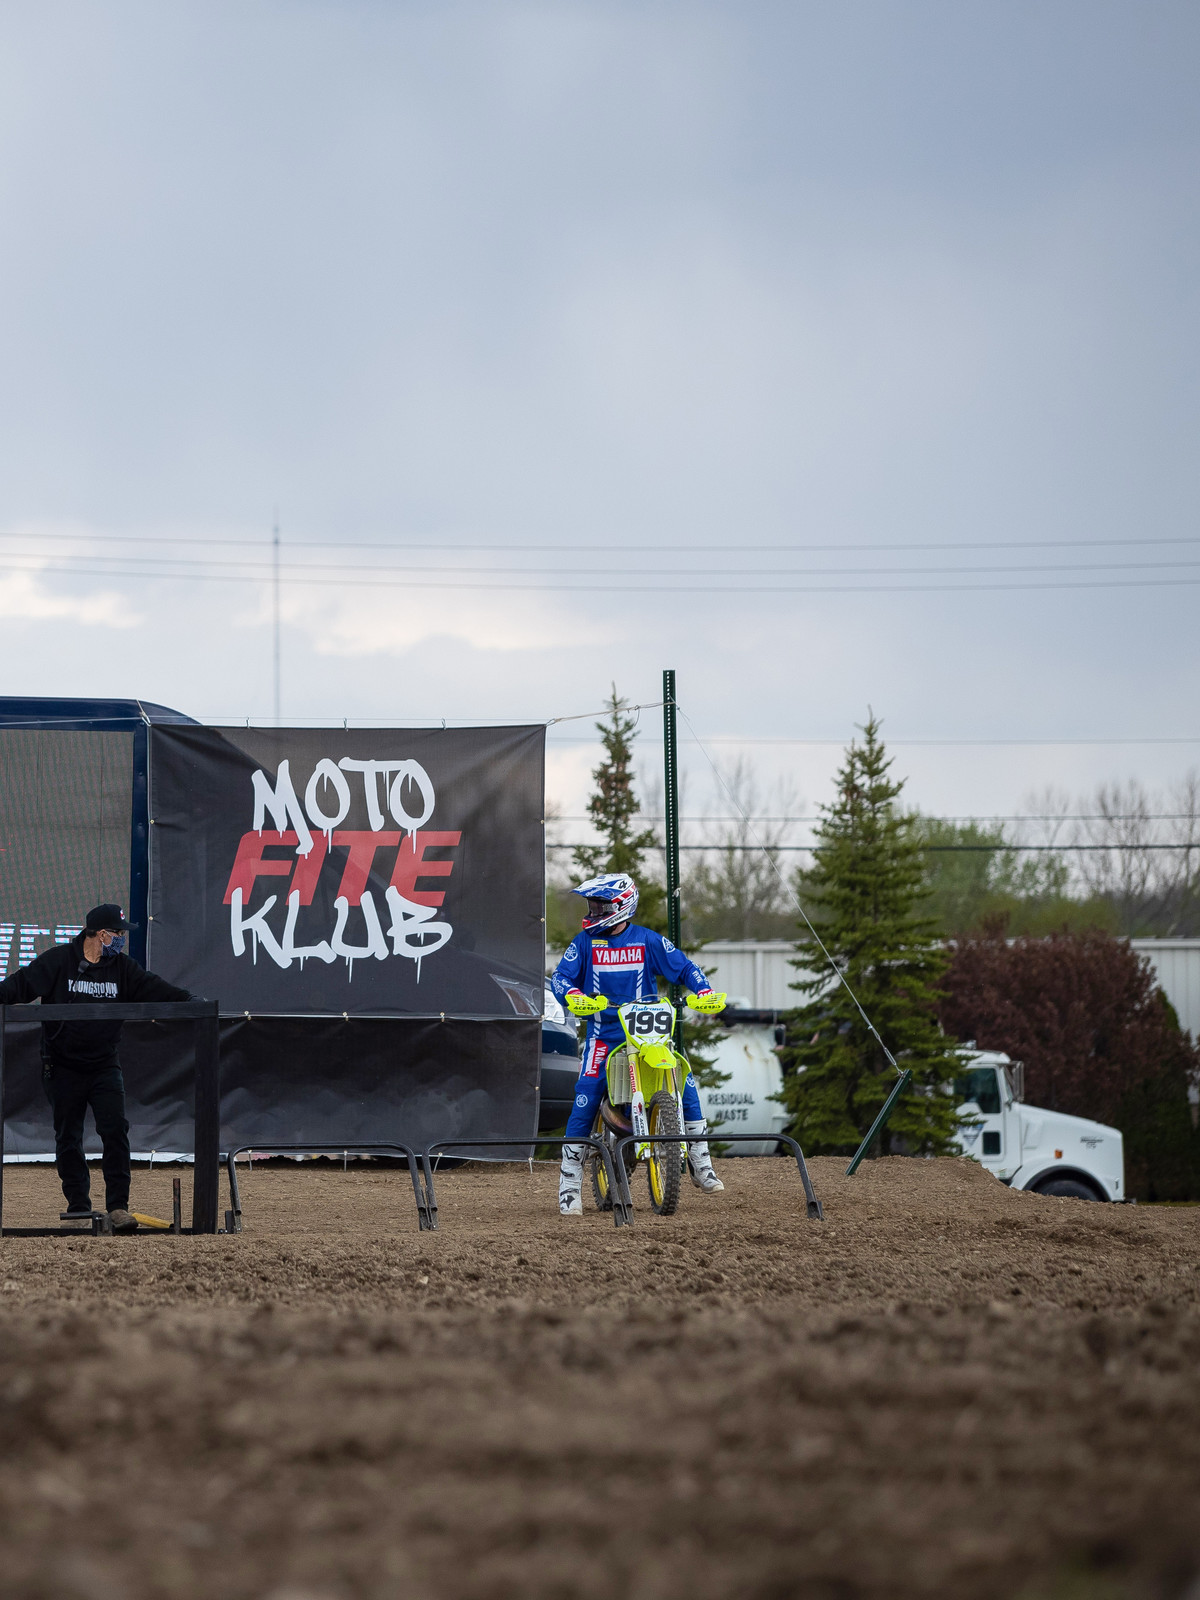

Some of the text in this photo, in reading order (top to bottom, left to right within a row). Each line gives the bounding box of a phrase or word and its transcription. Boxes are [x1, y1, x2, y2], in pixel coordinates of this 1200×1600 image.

[251, 757, 435, 859] MOTO
[222, 830, 462, 906] FITE
[230, 885, 453, 984] KLUB
[595, 948, 642, 963] YAMAHA
[68, 979, 118, 995] YOUNGSTOWN
[624, 1011, 673, 1036] 199
[708, 1093, 755, 1105] RESIDUAL
